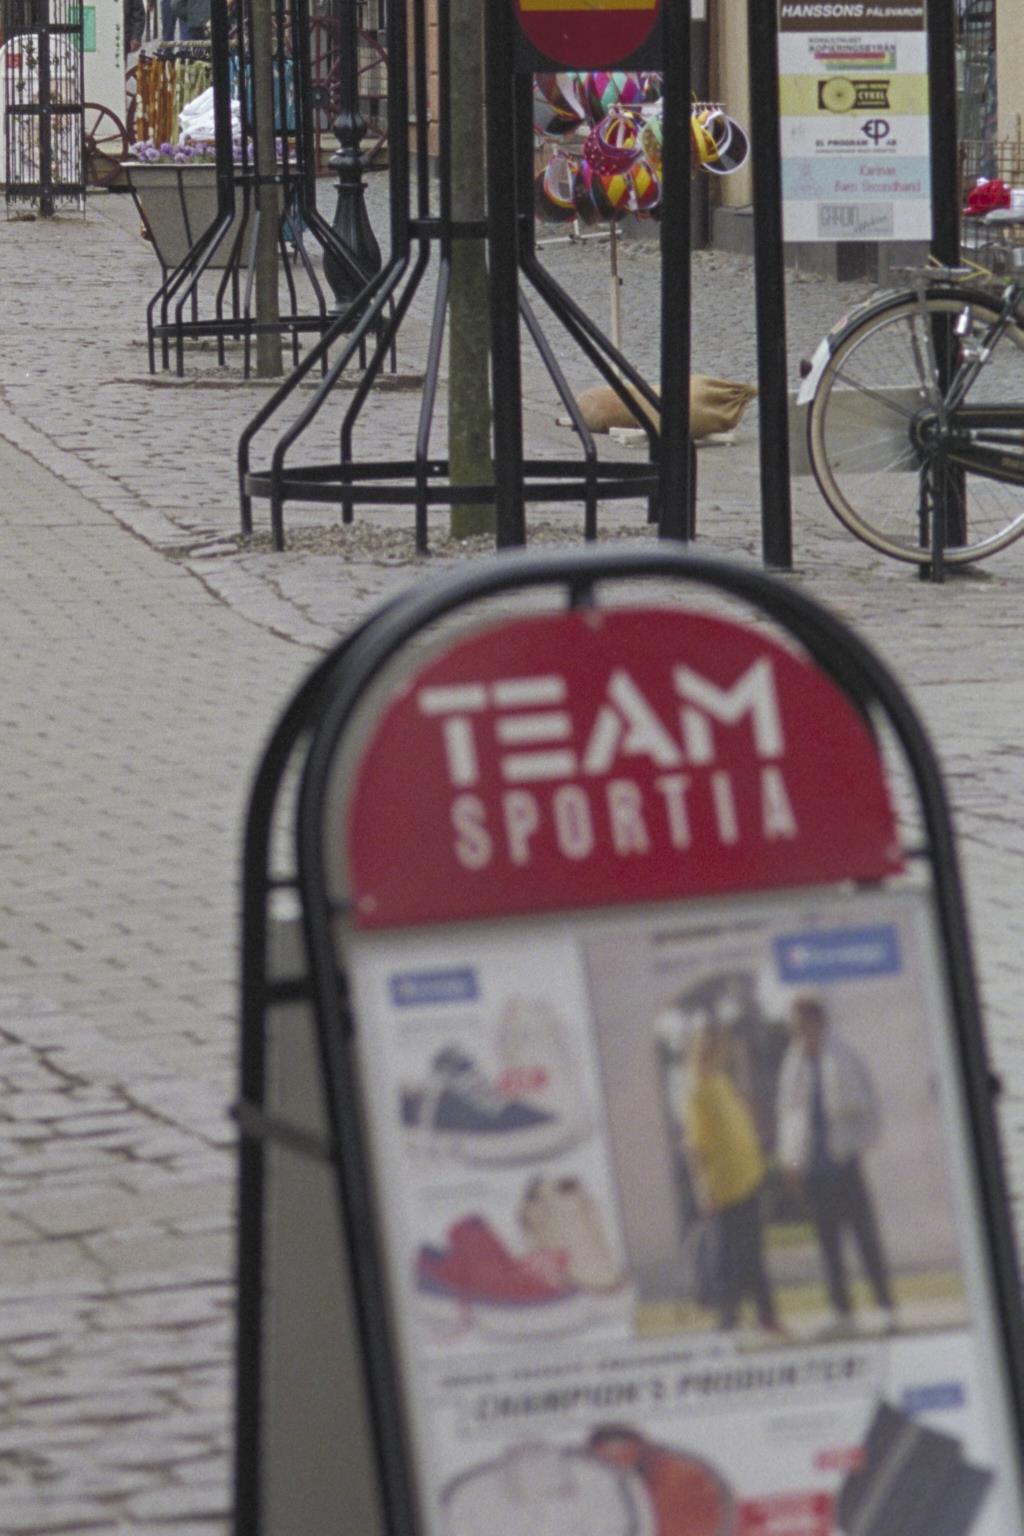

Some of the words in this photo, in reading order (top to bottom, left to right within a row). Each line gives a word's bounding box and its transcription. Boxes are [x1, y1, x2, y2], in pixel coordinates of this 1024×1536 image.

[782, 4, 864, 17] HANSSONS
[827, 139, 869, 147] PROGRAM
[418, 656, 785, 789] TEAM
[450, 763, 797, 870] SPORTIA
